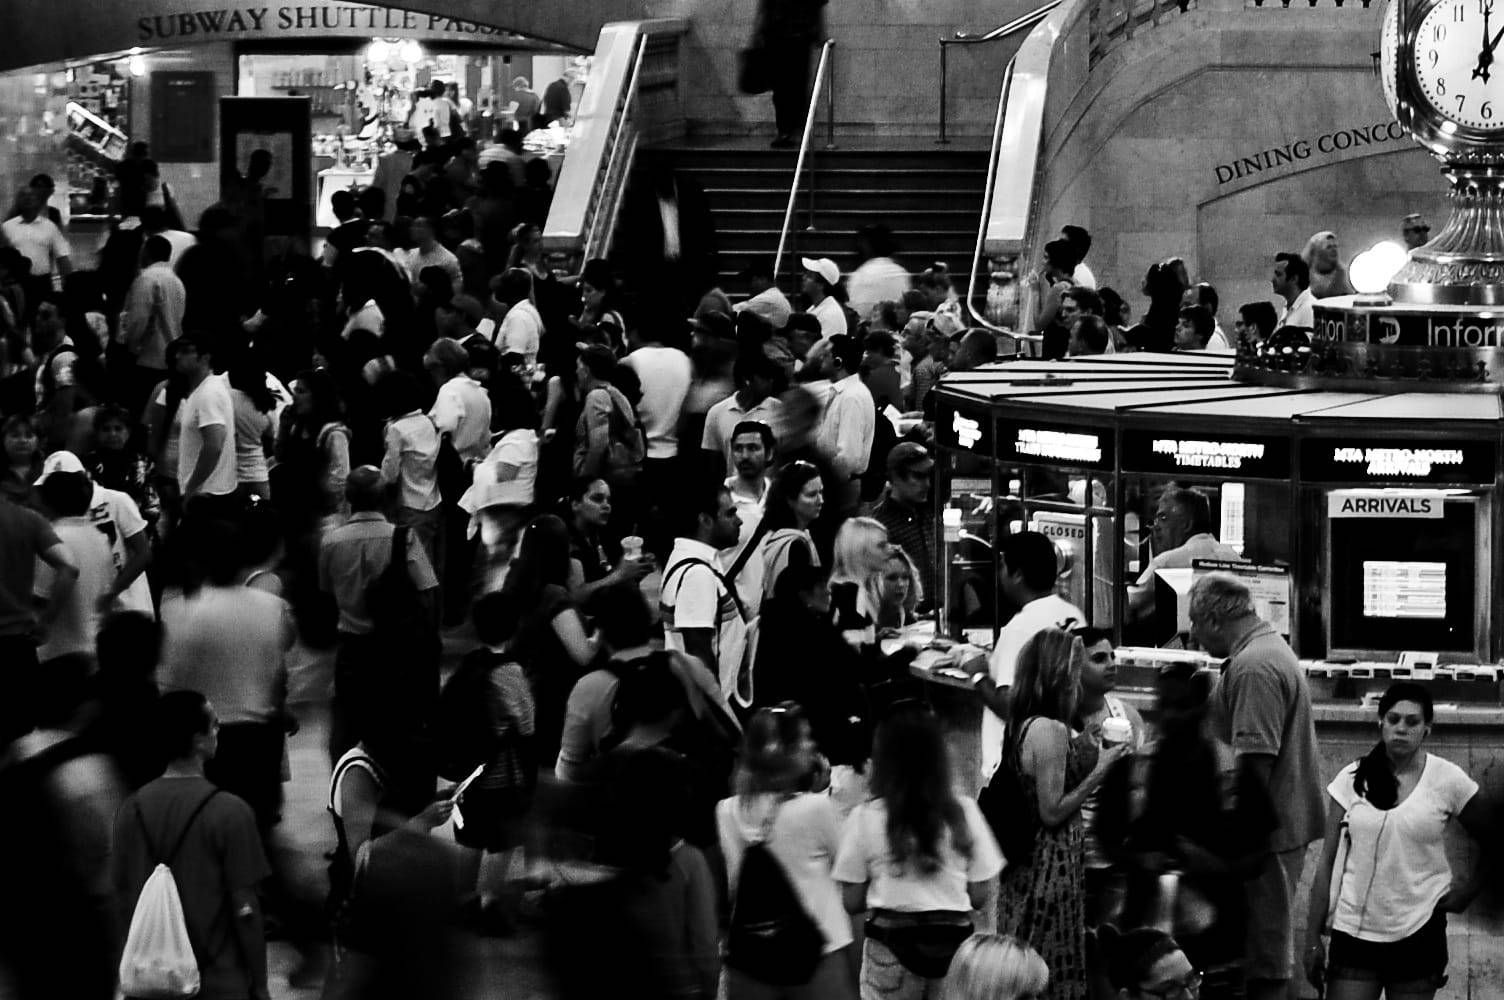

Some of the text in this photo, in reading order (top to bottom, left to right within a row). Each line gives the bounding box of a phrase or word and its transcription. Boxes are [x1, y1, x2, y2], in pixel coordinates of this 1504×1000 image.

[138, 7, 268, 41] SUBWAY
[278, 6, 417, 30] SHUTTLE
[1215, 140, 1312, 185] DINING
[1341, 498, 1432, 513] ARRIVALS
[1043, 525, 1085, 539] CLOSED
